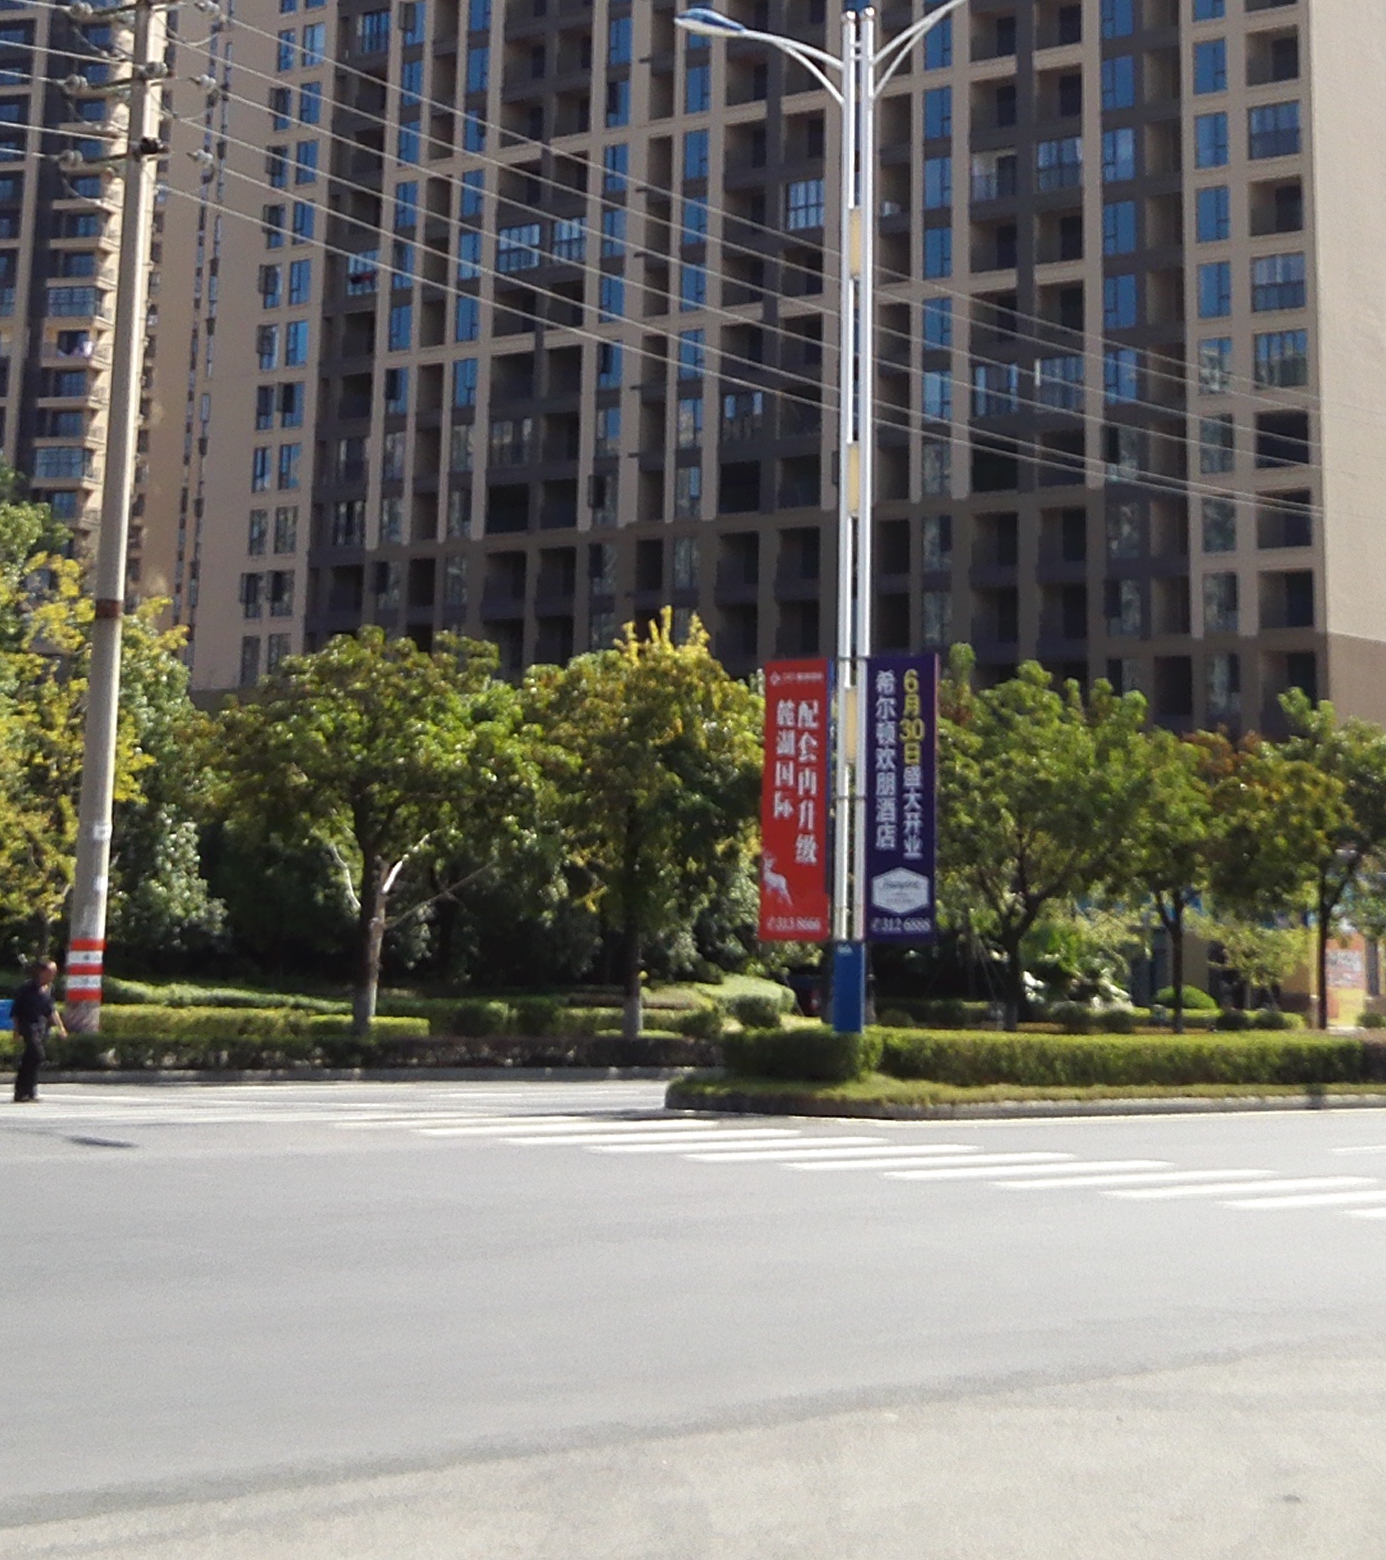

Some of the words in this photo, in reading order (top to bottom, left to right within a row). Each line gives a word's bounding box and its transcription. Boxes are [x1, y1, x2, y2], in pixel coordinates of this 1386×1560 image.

[874, 669, 897, 851] 希尔顿欢朋酒店
